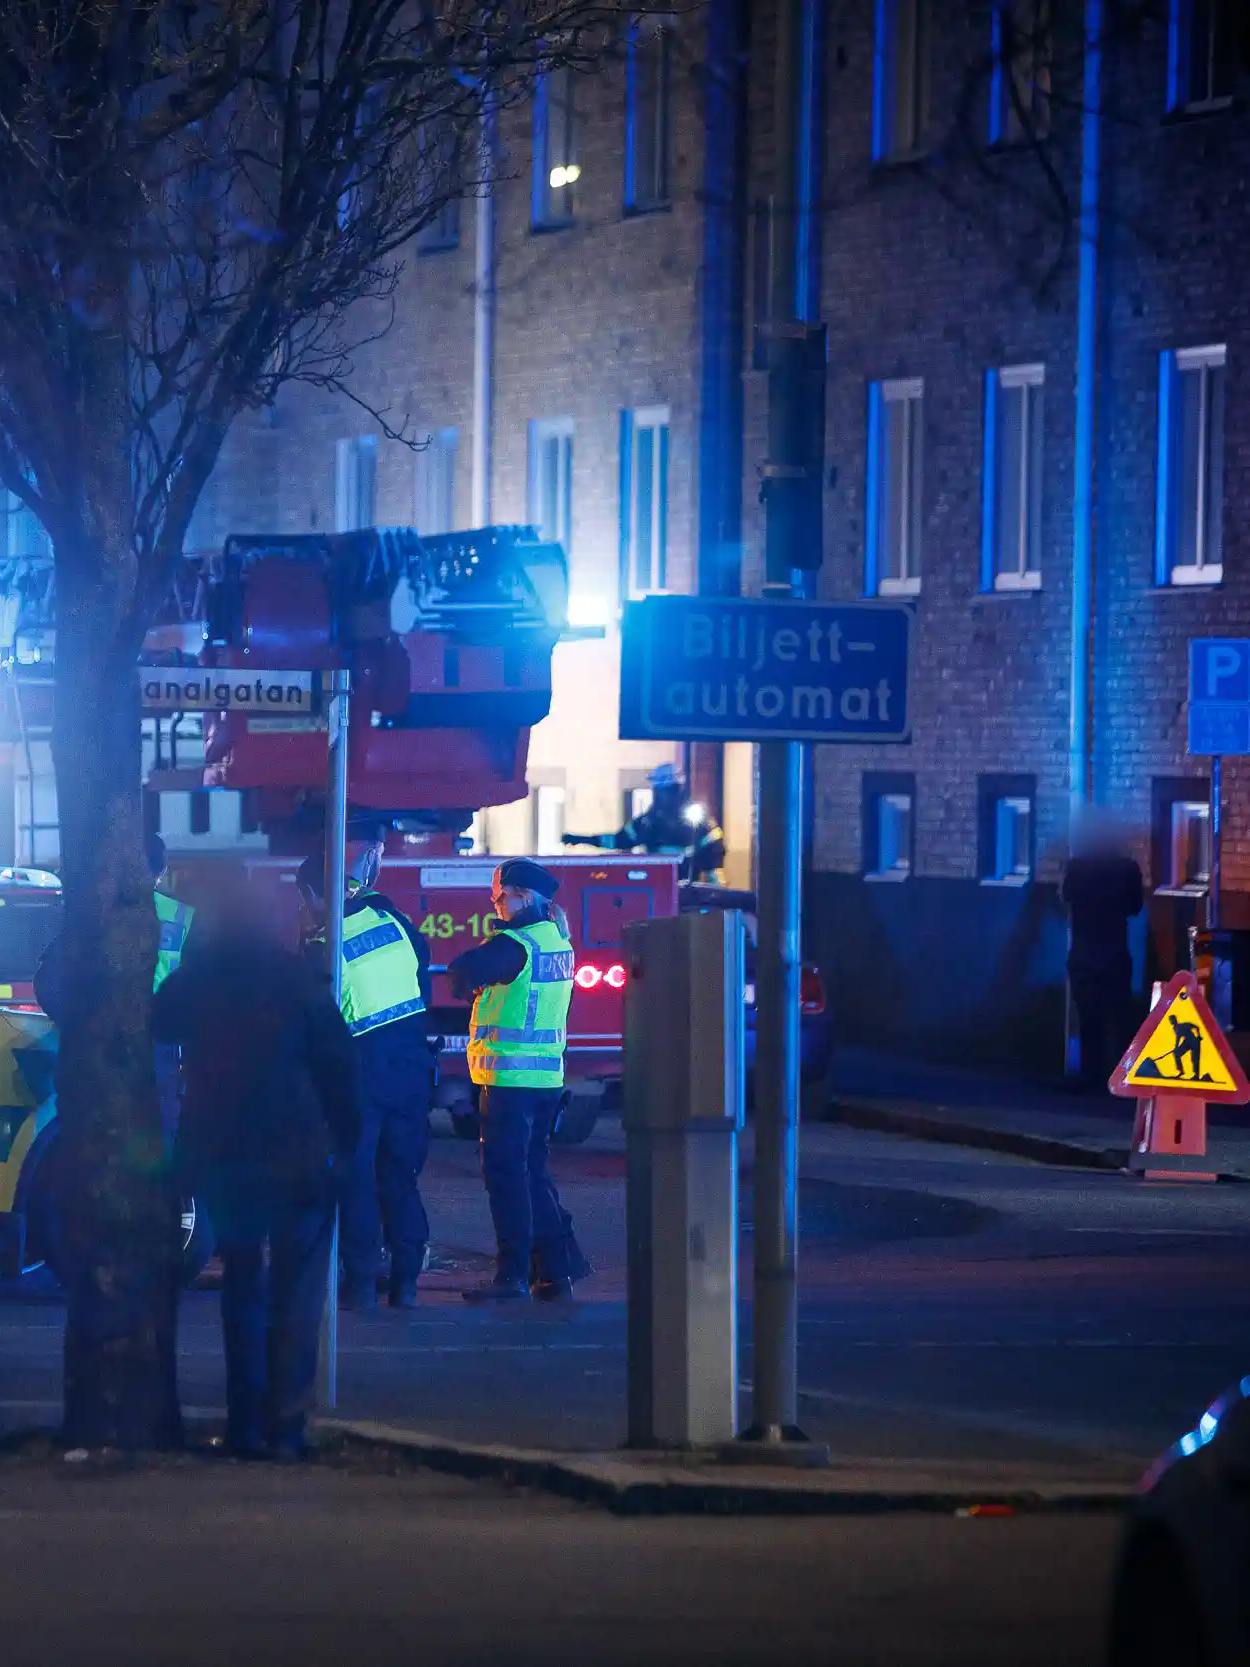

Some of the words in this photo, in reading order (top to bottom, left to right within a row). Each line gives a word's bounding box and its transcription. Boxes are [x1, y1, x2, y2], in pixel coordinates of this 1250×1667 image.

[684, 611, 876, 671] Biljett-
[143, 676, 302, 706] analgatan
[1207, 646, 1241, 697] P
[666, 673, 893, 721] automat
